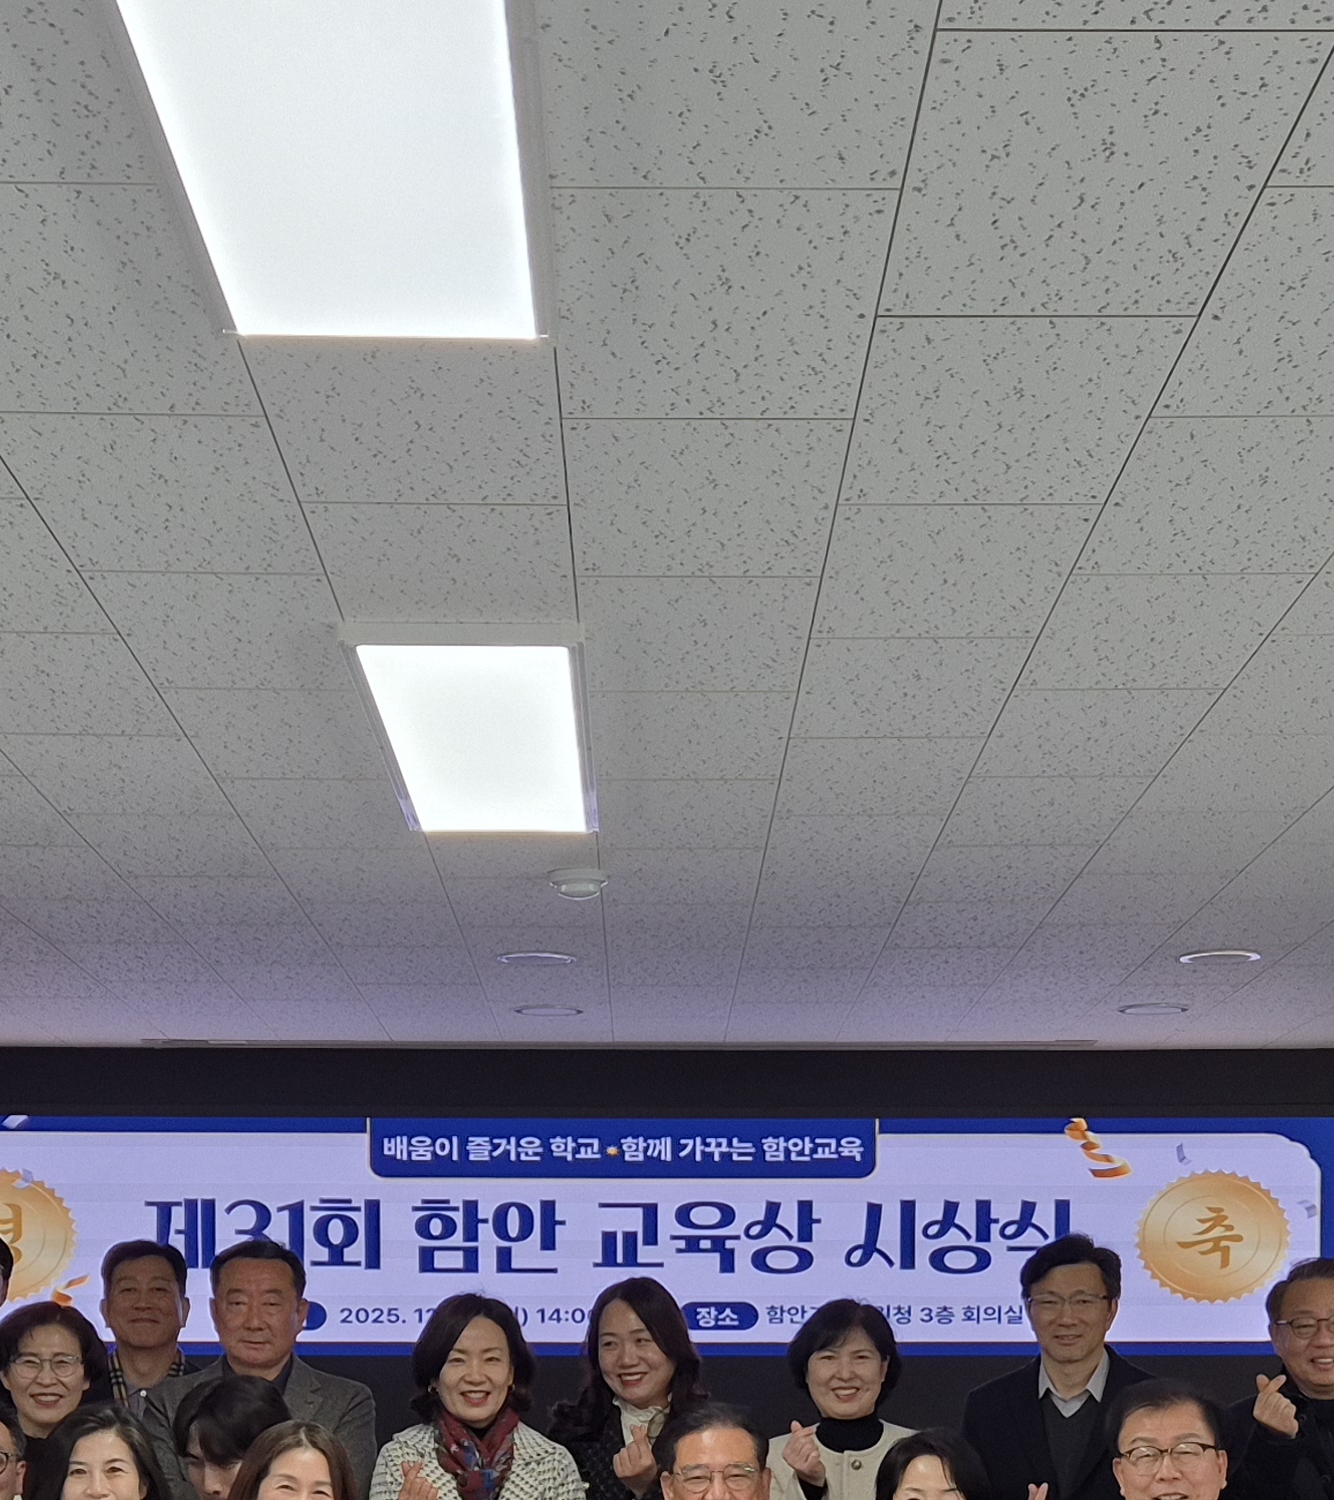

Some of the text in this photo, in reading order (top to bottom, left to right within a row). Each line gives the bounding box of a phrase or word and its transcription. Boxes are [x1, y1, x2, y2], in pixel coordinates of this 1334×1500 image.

[382, 1135, 865, 1163] 배움이 즐거운 학교 함께 가꾸는 함안교육
[144, 1197, 1071, 1275] 제31회 함안 교육상 시상식
[1175, 1205, 1244, 1271] 축
[339, 1306, 407, 1325] 2025.
[536, 1307, 592, 1325] 14:0
[695, 1306, 740, 1328] 장소
[919, 1305, 956, 1325] 3층
[961, 1304, 1025, 1326] 회의실
